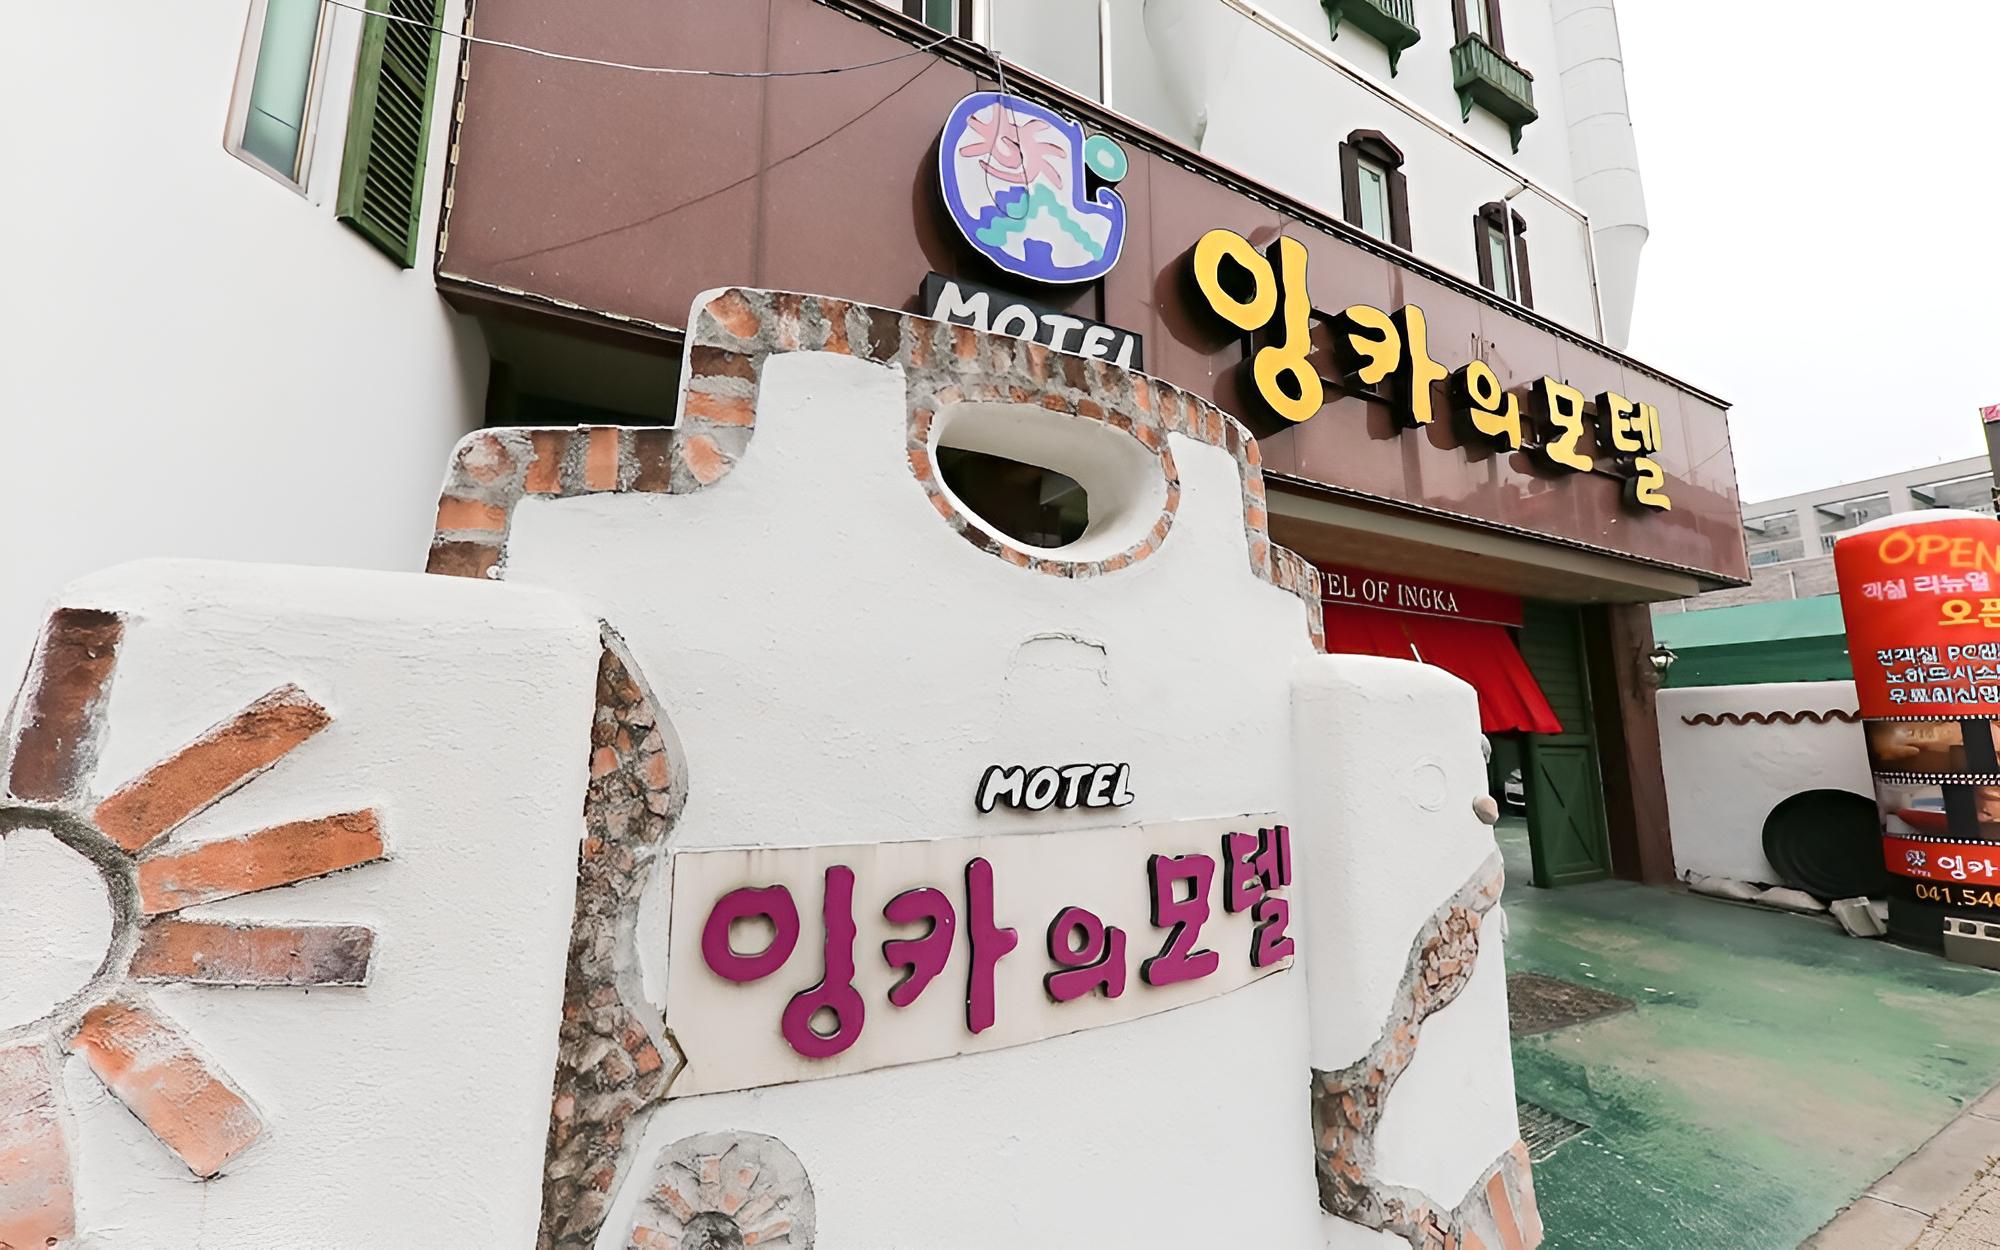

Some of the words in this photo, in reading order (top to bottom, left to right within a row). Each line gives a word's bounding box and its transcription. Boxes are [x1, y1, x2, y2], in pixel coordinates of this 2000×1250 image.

[1878, 531, 2000, 573] OPEN
[1321, 571, 1356, 599] EL
[1362, 578, 1390, 602] OF
[1398, 584, 1459, 613] INGKA
[1913, 571, 1991, 595] 리뉴얼
[1886, 663, 2000, 685] 노하드시스
[975, 763, 1135, 813] MOTEL
